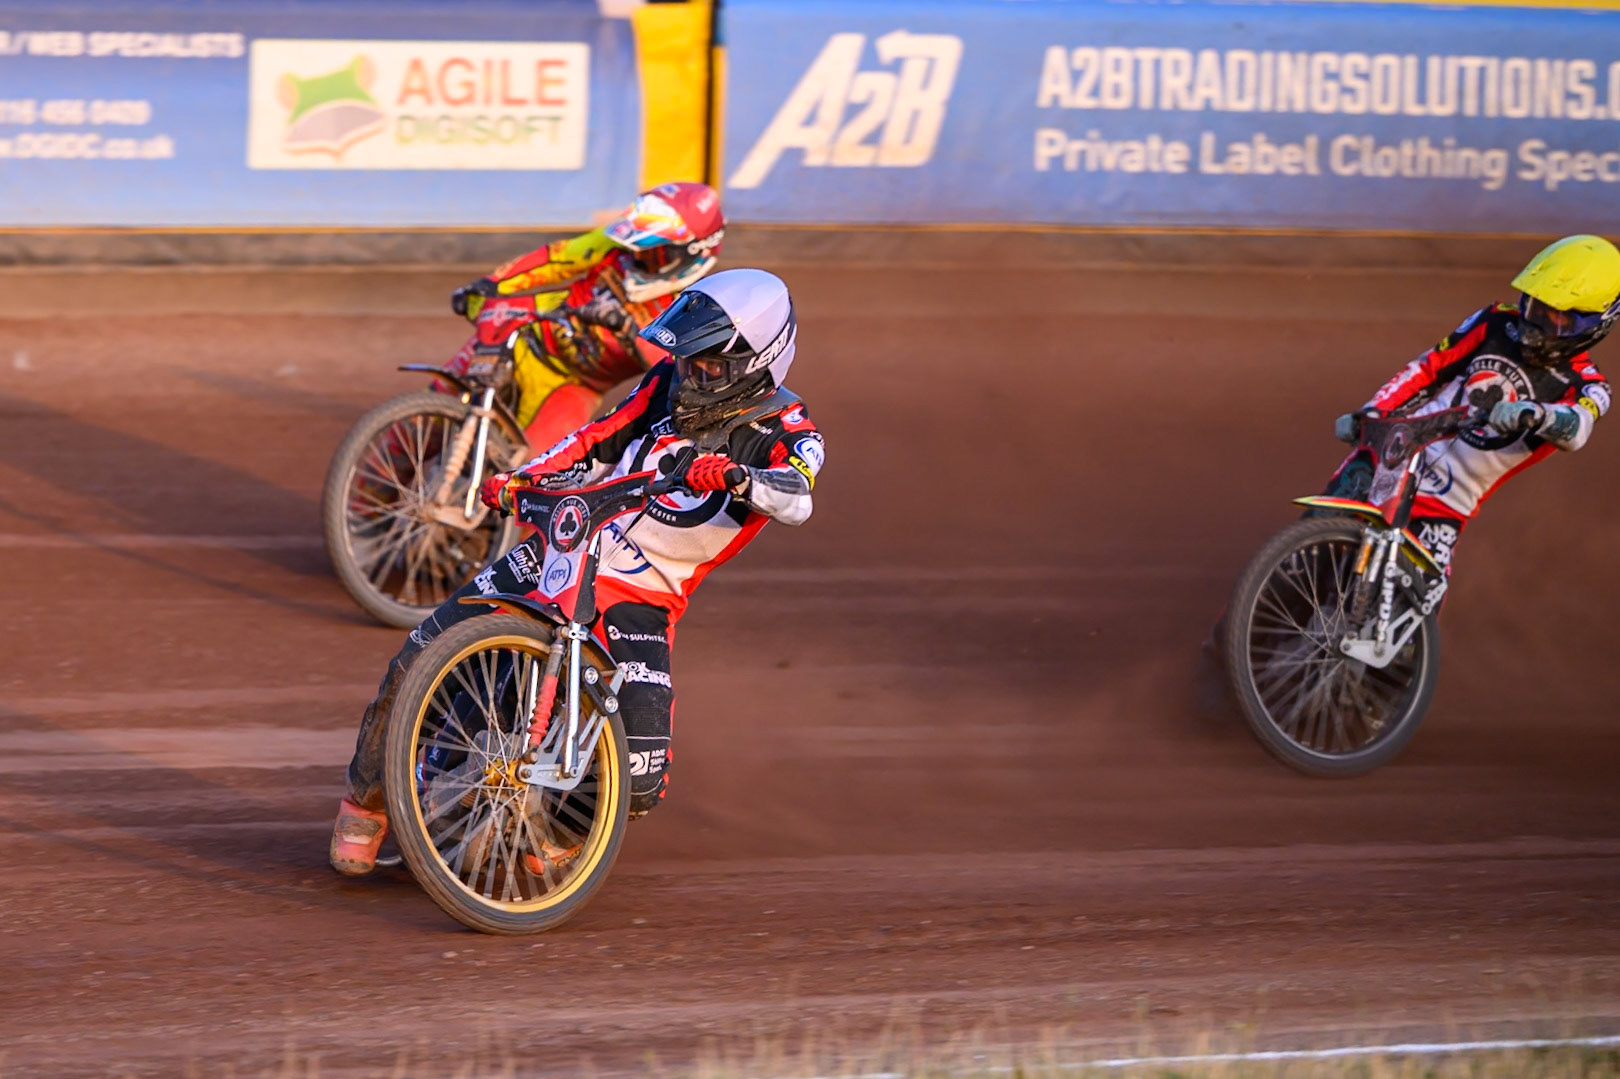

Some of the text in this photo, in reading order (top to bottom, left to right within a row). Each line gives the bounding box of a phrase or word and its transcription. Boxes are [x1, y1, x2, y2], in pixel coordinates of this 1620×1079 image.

[88, 32, 245, 57] SPECIALISTS
[397, 57, 568, 107] AGILE
[395, 114, 563, 145] DIGISOFT
[727, 30, 964, 189] A2B
[1034, 128, 1620, 191] Private Label Clothing Spec
